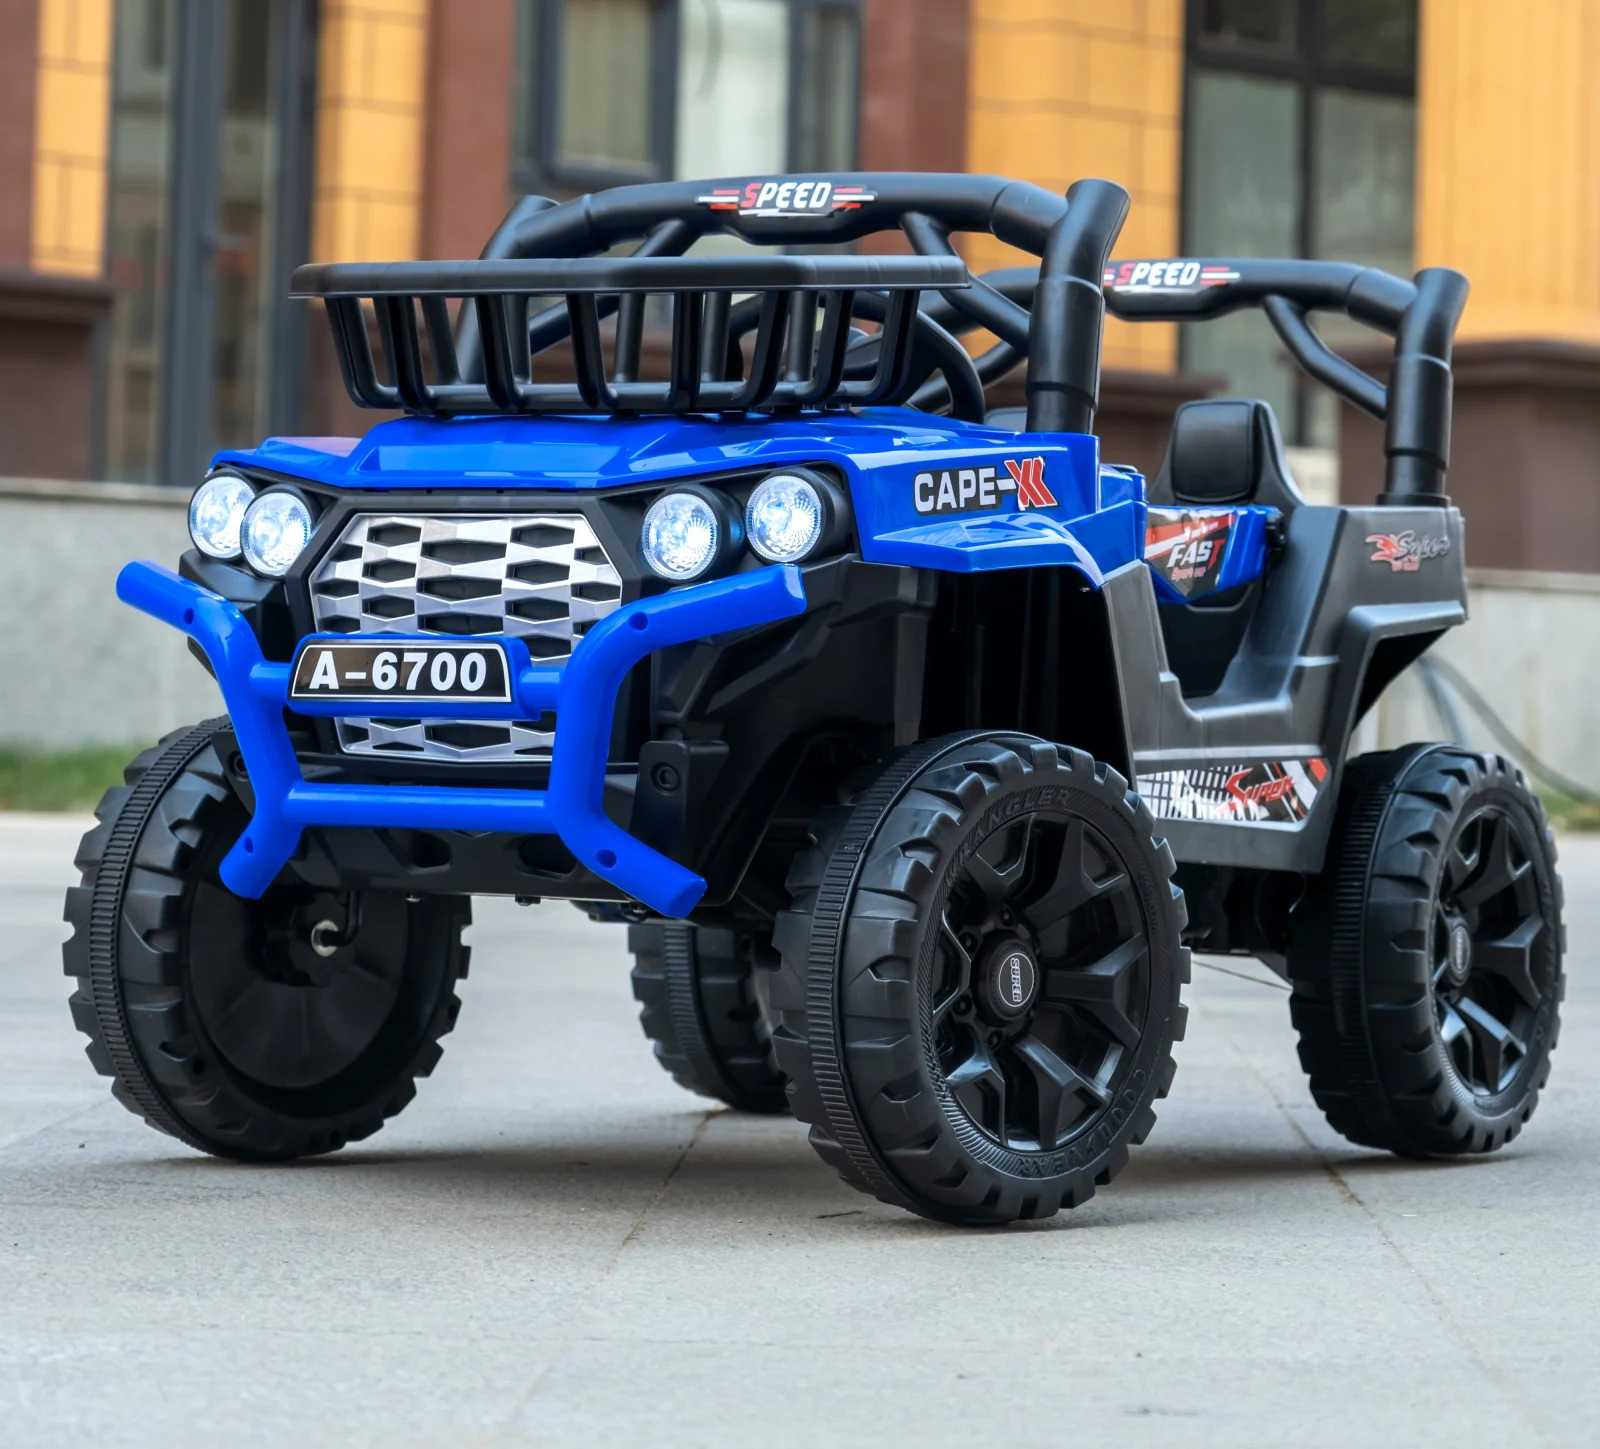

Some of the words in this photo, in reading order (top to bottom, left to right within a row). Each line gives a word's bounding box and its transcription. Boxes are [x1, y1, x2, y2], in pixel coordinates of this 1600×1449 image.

[740, 182, 832, 209] SPEED
[1115, 262, 1201, 286] SPEED
[1166, 539, 1226, 570] FAST
[308, 650, 488, 692] A-6700
[1010, 957, 1023, 1002] SUPER
